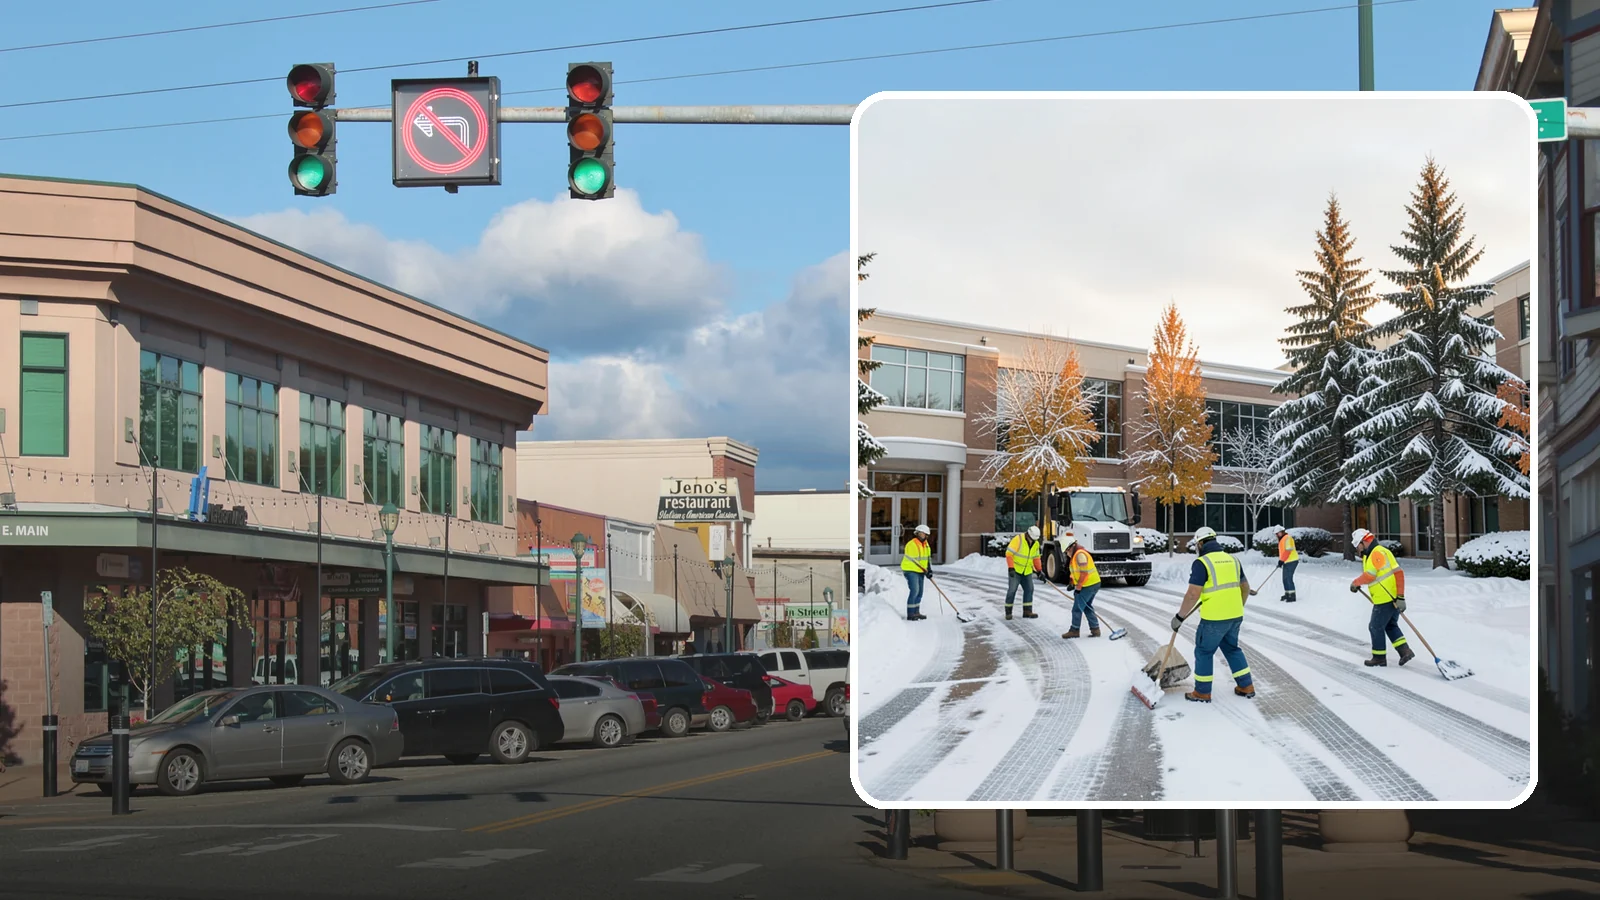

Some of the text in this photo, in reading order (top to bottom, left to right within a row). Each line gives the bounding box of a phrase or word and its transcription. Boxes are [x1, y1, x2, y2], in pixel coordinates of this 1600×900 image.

[670, 480, 727, 494] Jeno's
[665, 496, 730, 508] restaurant
[658, 510, 681, 519] Italian
[686, 510, 714, 519] American
[715, 510, 737, 519] Cuisine
[2, 526, 48, 536] E. MAIN
[798, 608, 828, 616] Street
[788, 619, 823, 627] lass
